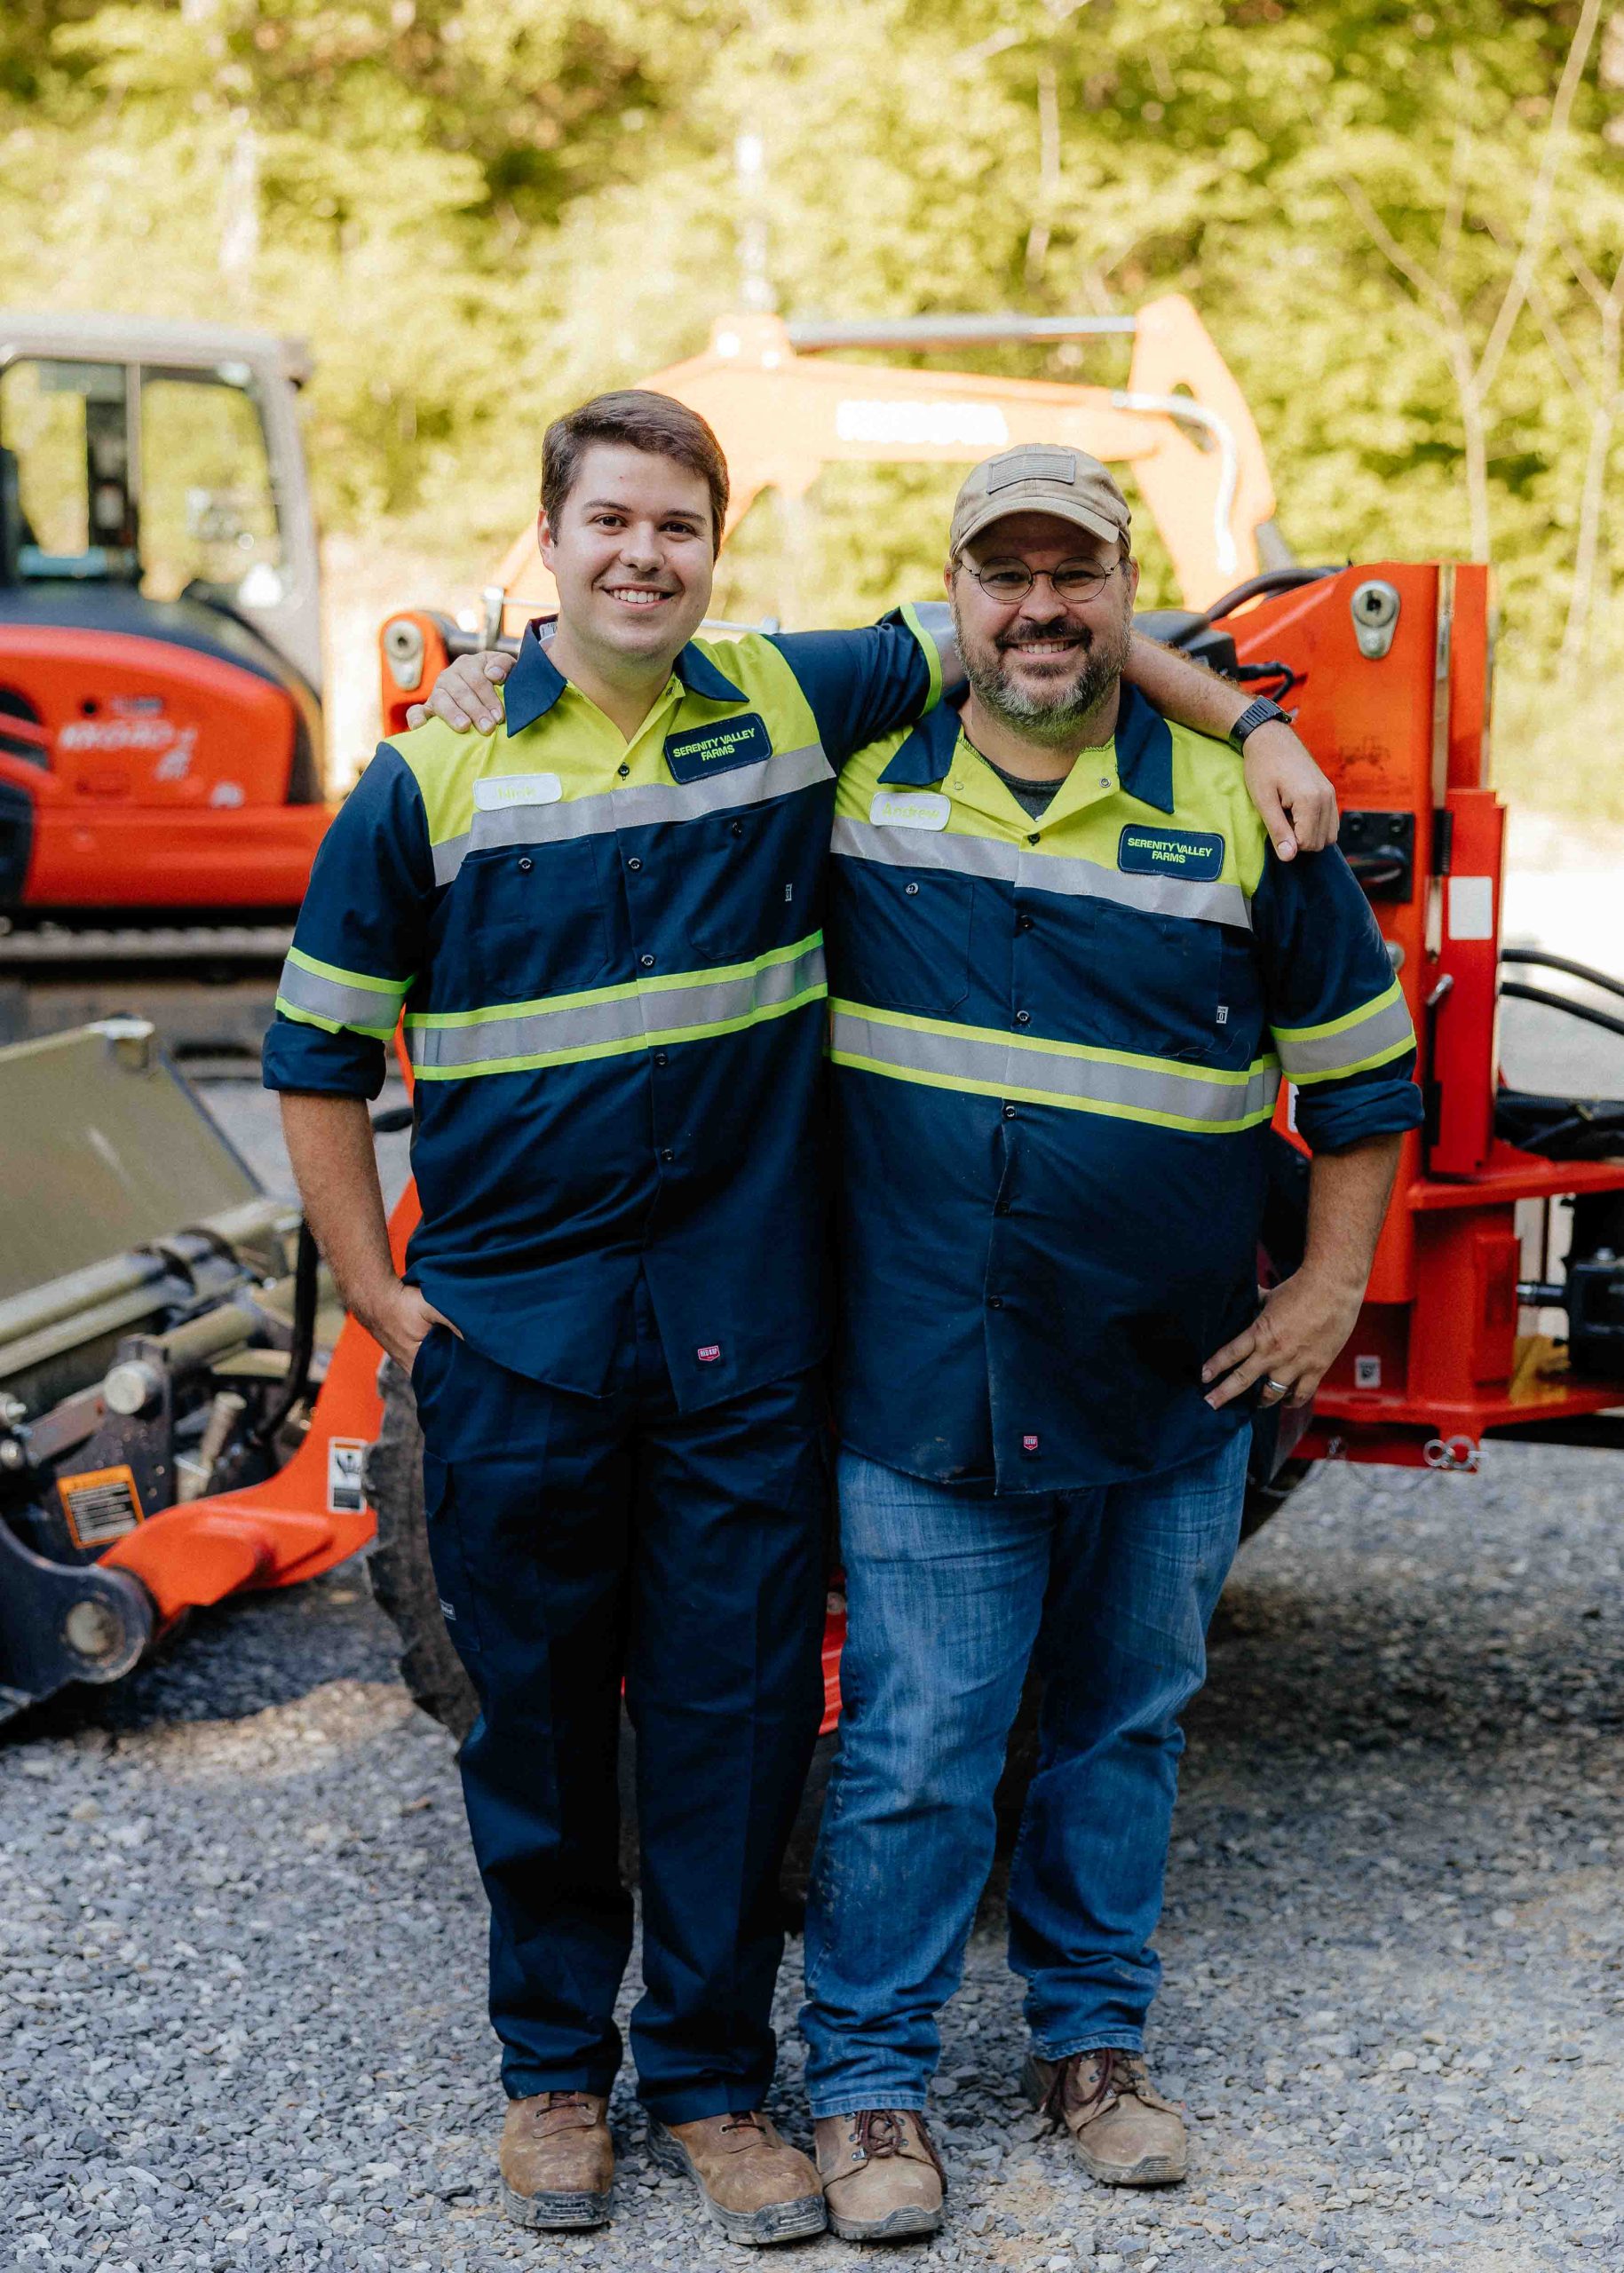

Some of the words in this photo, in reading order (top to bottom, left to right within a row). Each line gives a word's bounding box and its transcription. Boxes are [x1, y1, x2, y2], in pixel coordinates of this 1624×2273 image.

[673, 738, 718, 757] SERENITY
[719, 728, 755, 744] VALLEY
[701, 745, 734, 761] FARMS
[1128, 838, 1175, 851] SERENITY
[1176, 843, 1213, 857] VALLEY
[1152, 851, 1185, 863] FARMS
